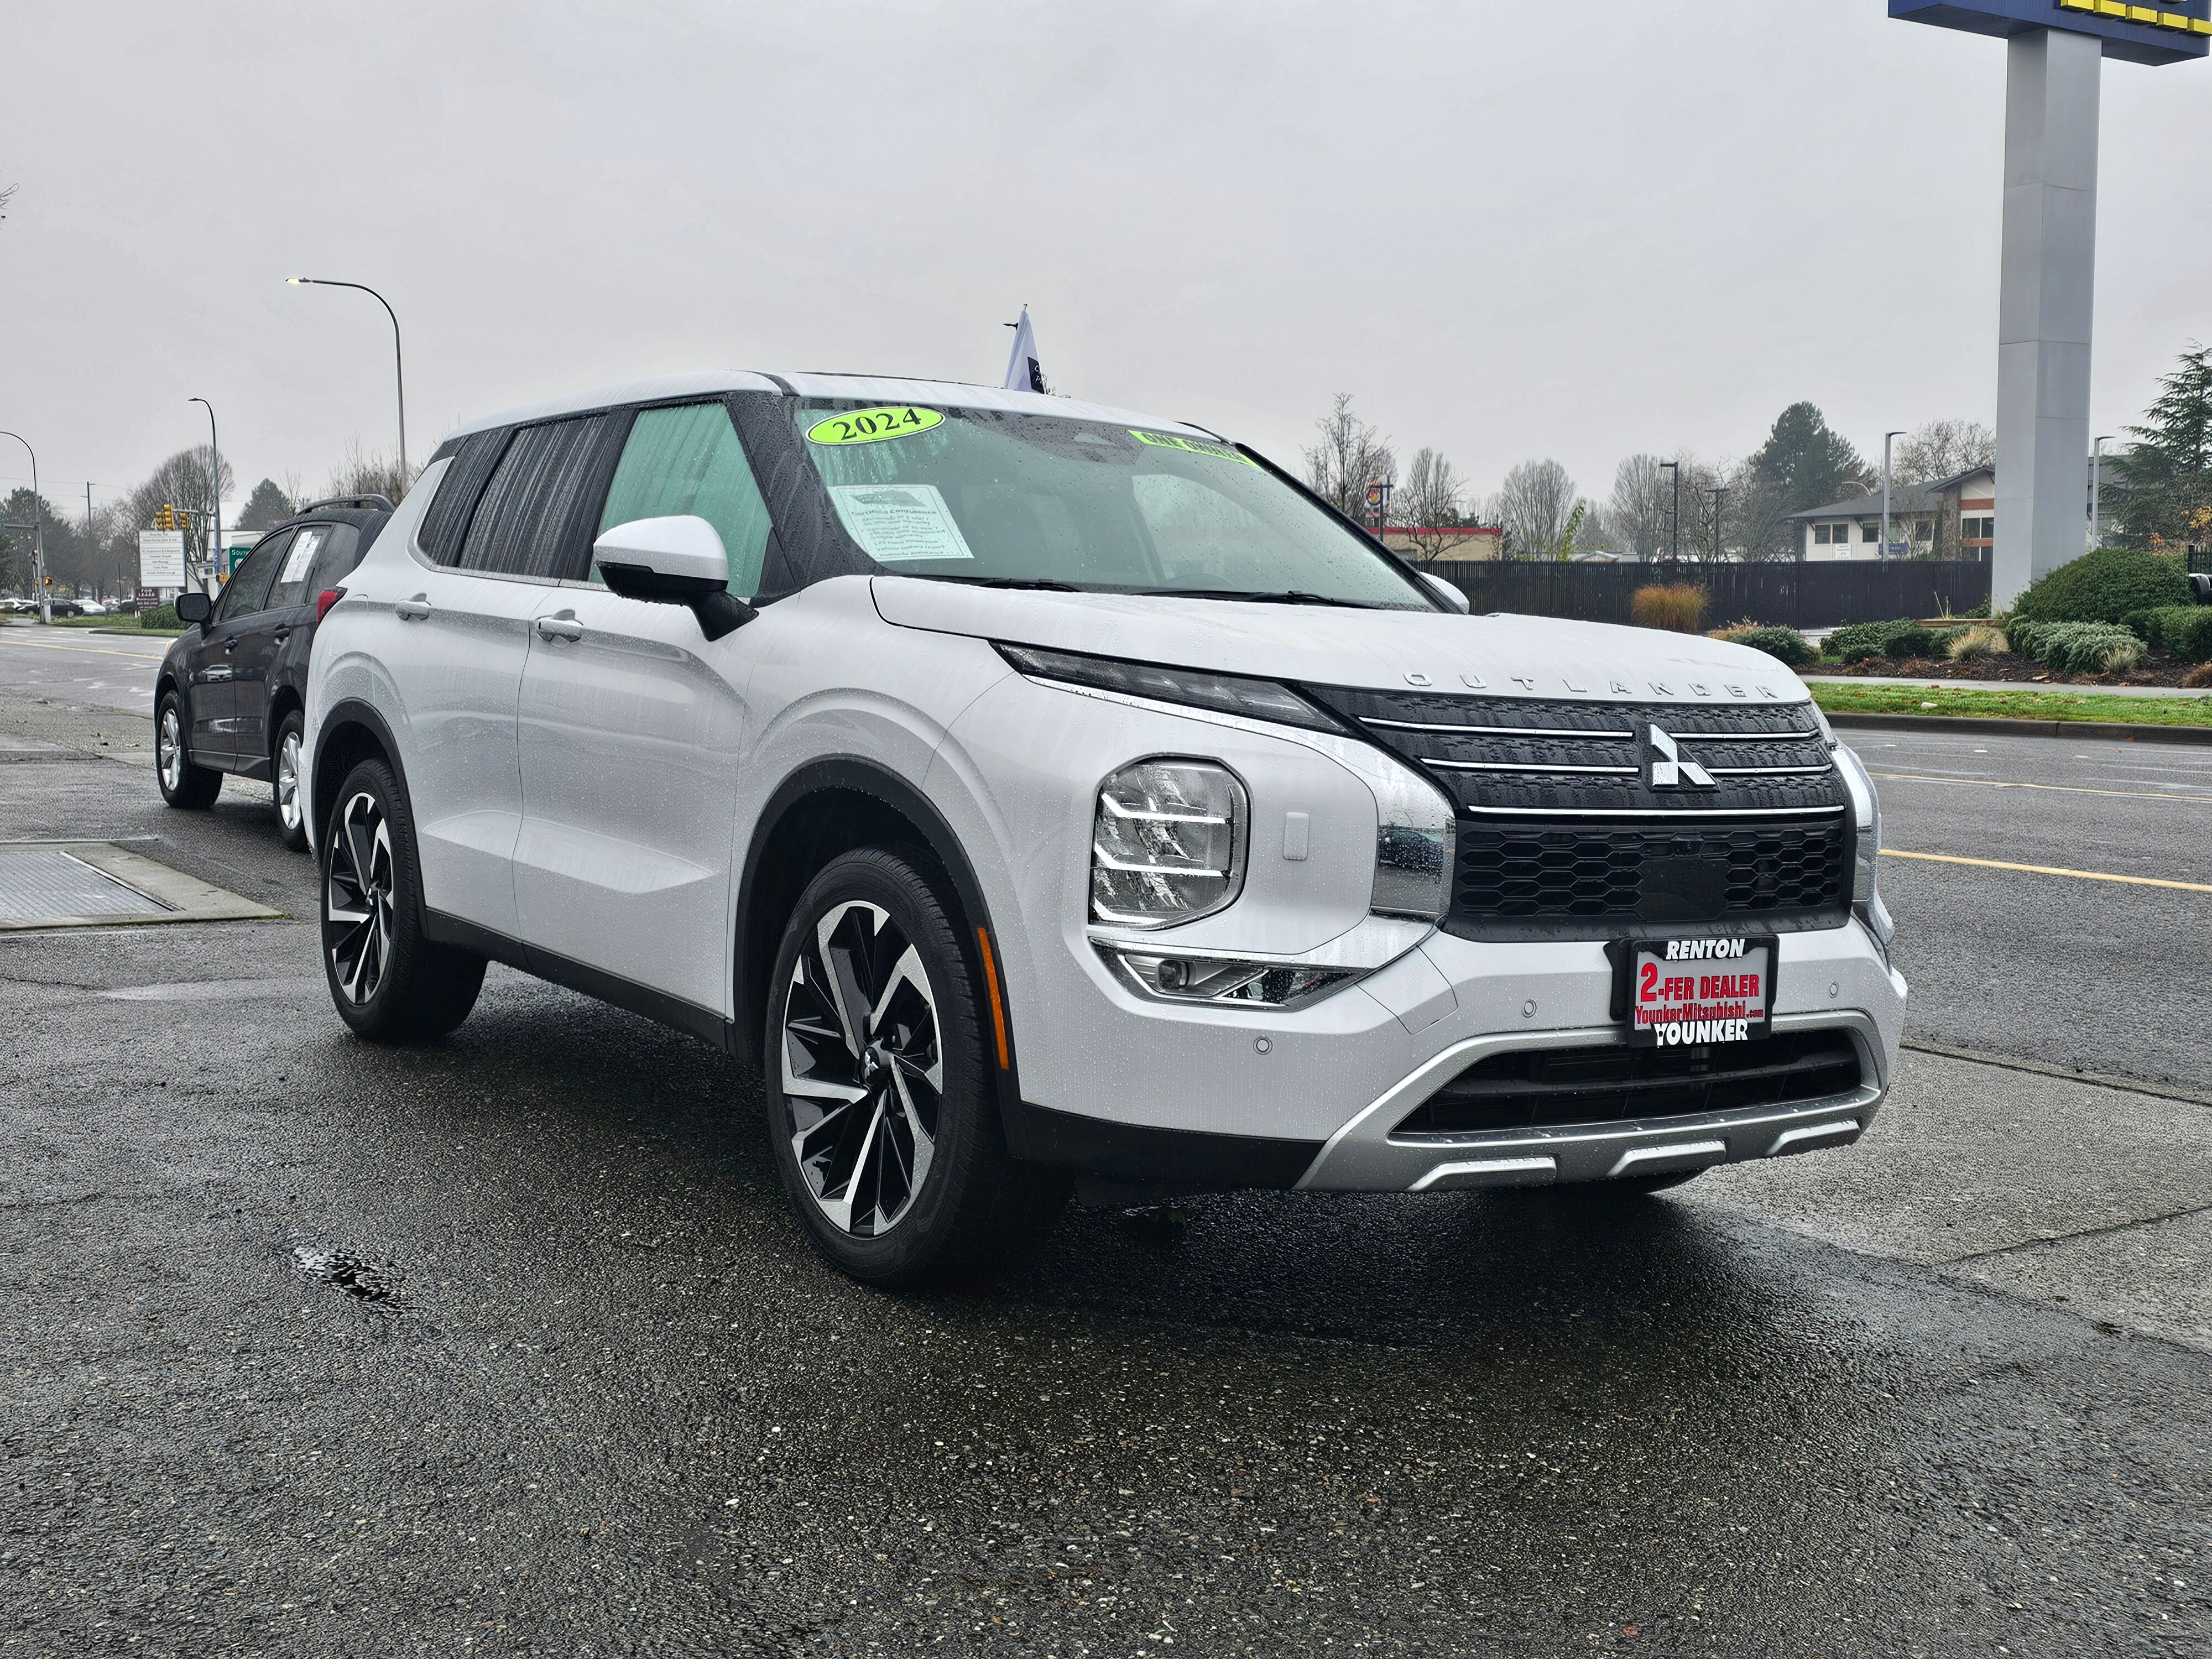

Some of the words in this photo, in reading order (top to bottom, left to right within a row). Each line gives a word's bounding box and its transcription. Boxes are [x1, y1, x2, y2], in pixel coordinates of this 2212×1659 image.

[833, 408, 921, 440] 2024
[1402, 671, 1778, 698] OUTLANDER
[1666, 938, 1745, 960] RENTON
[1640, 962, 1694, 1002] 2-FER
[1699, 974, 1760, 999] DEALER
[1653, 1019, 1748, 1046] YOUNKER
